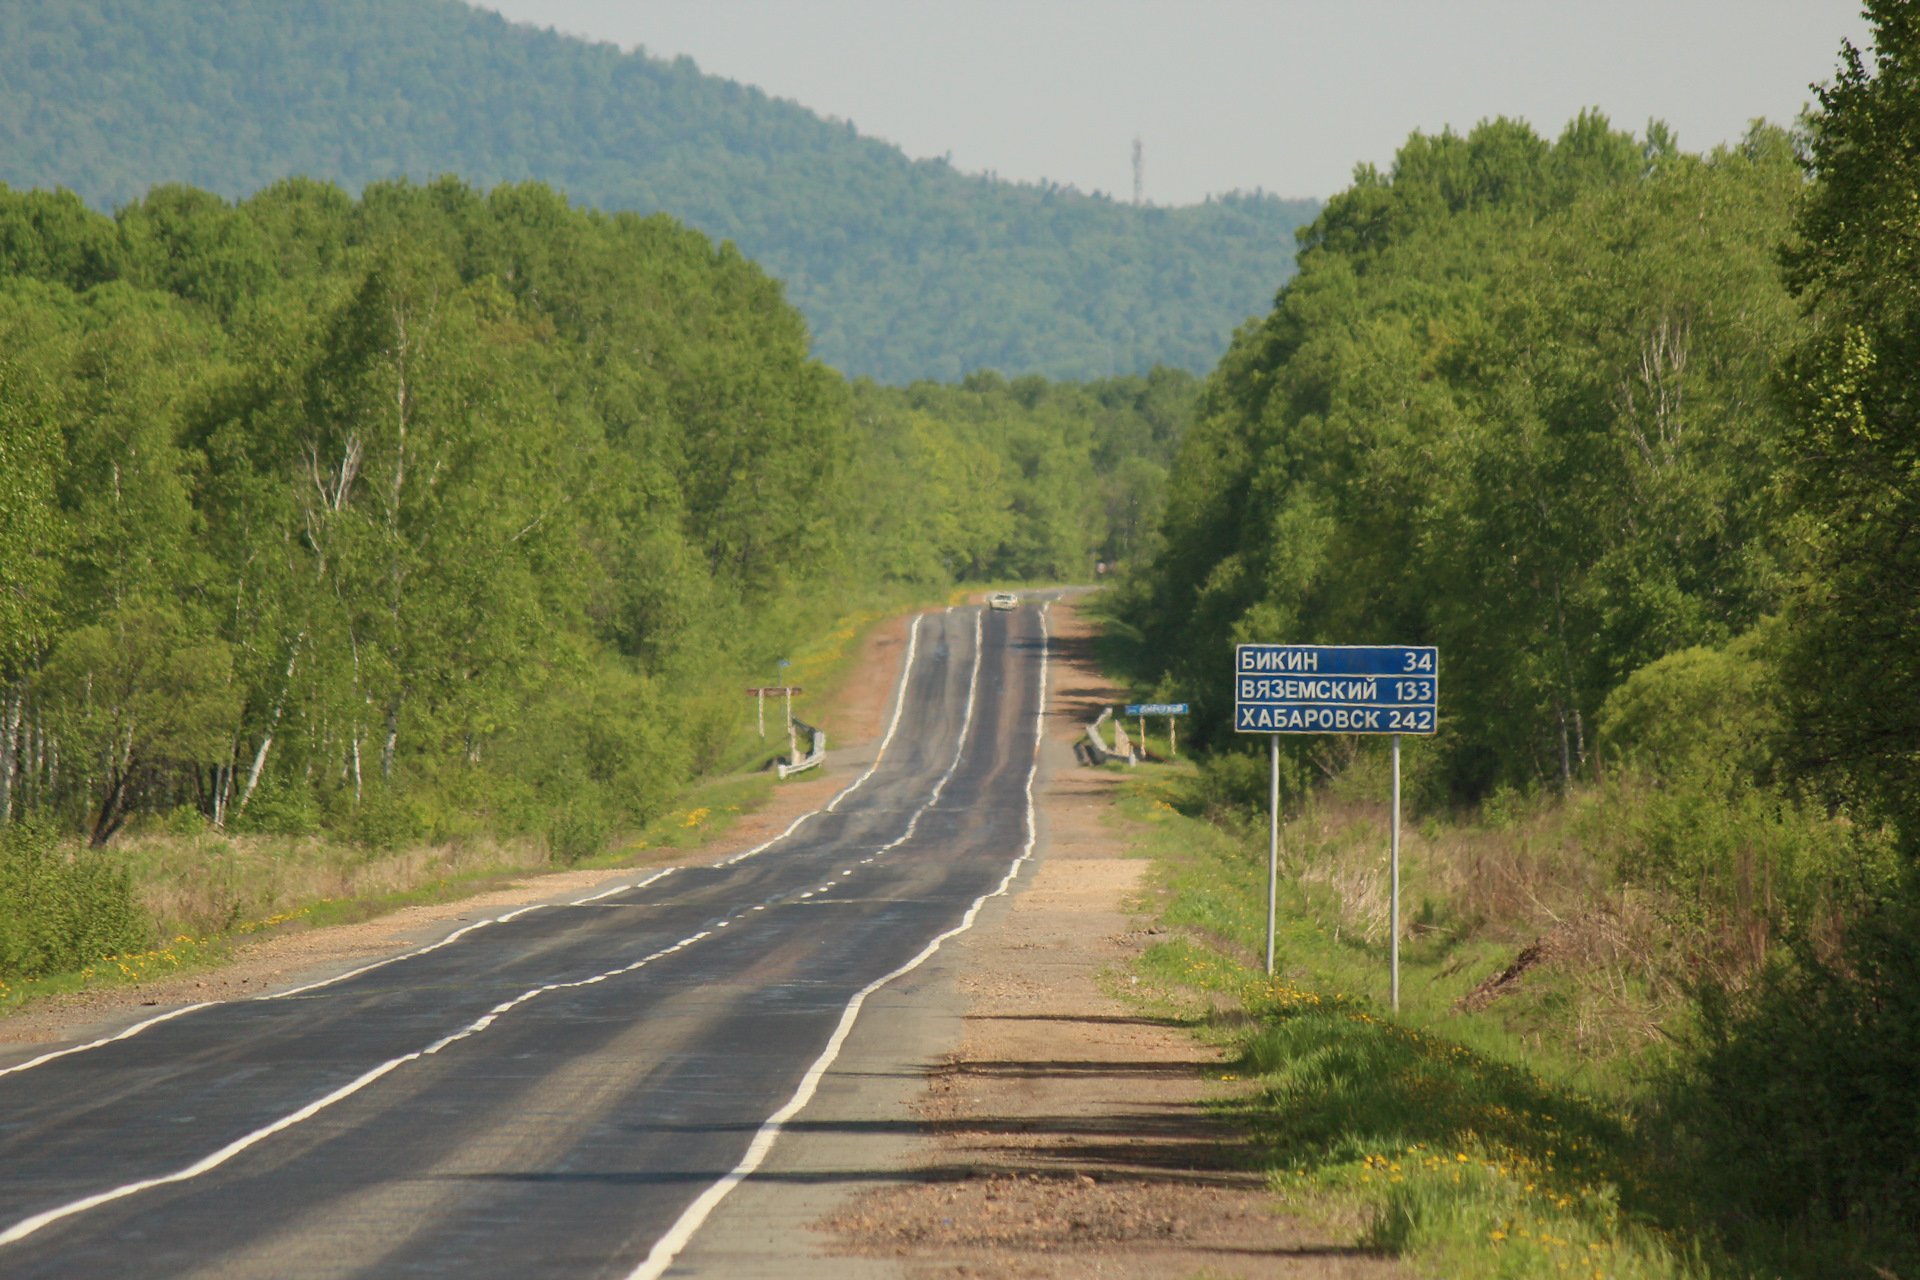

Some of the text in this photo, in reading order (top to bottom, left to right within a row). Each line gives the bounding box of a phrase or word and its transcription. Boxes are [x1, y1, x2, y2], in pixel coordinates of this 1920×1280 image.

[1241, 651, 1432, 672] БИКИН 34
[1241, 677, 1432, 701] ВЯЗЕМСКИЙ 133
[1240, 708, 1431, 729] ХАБАРОВСК 242
